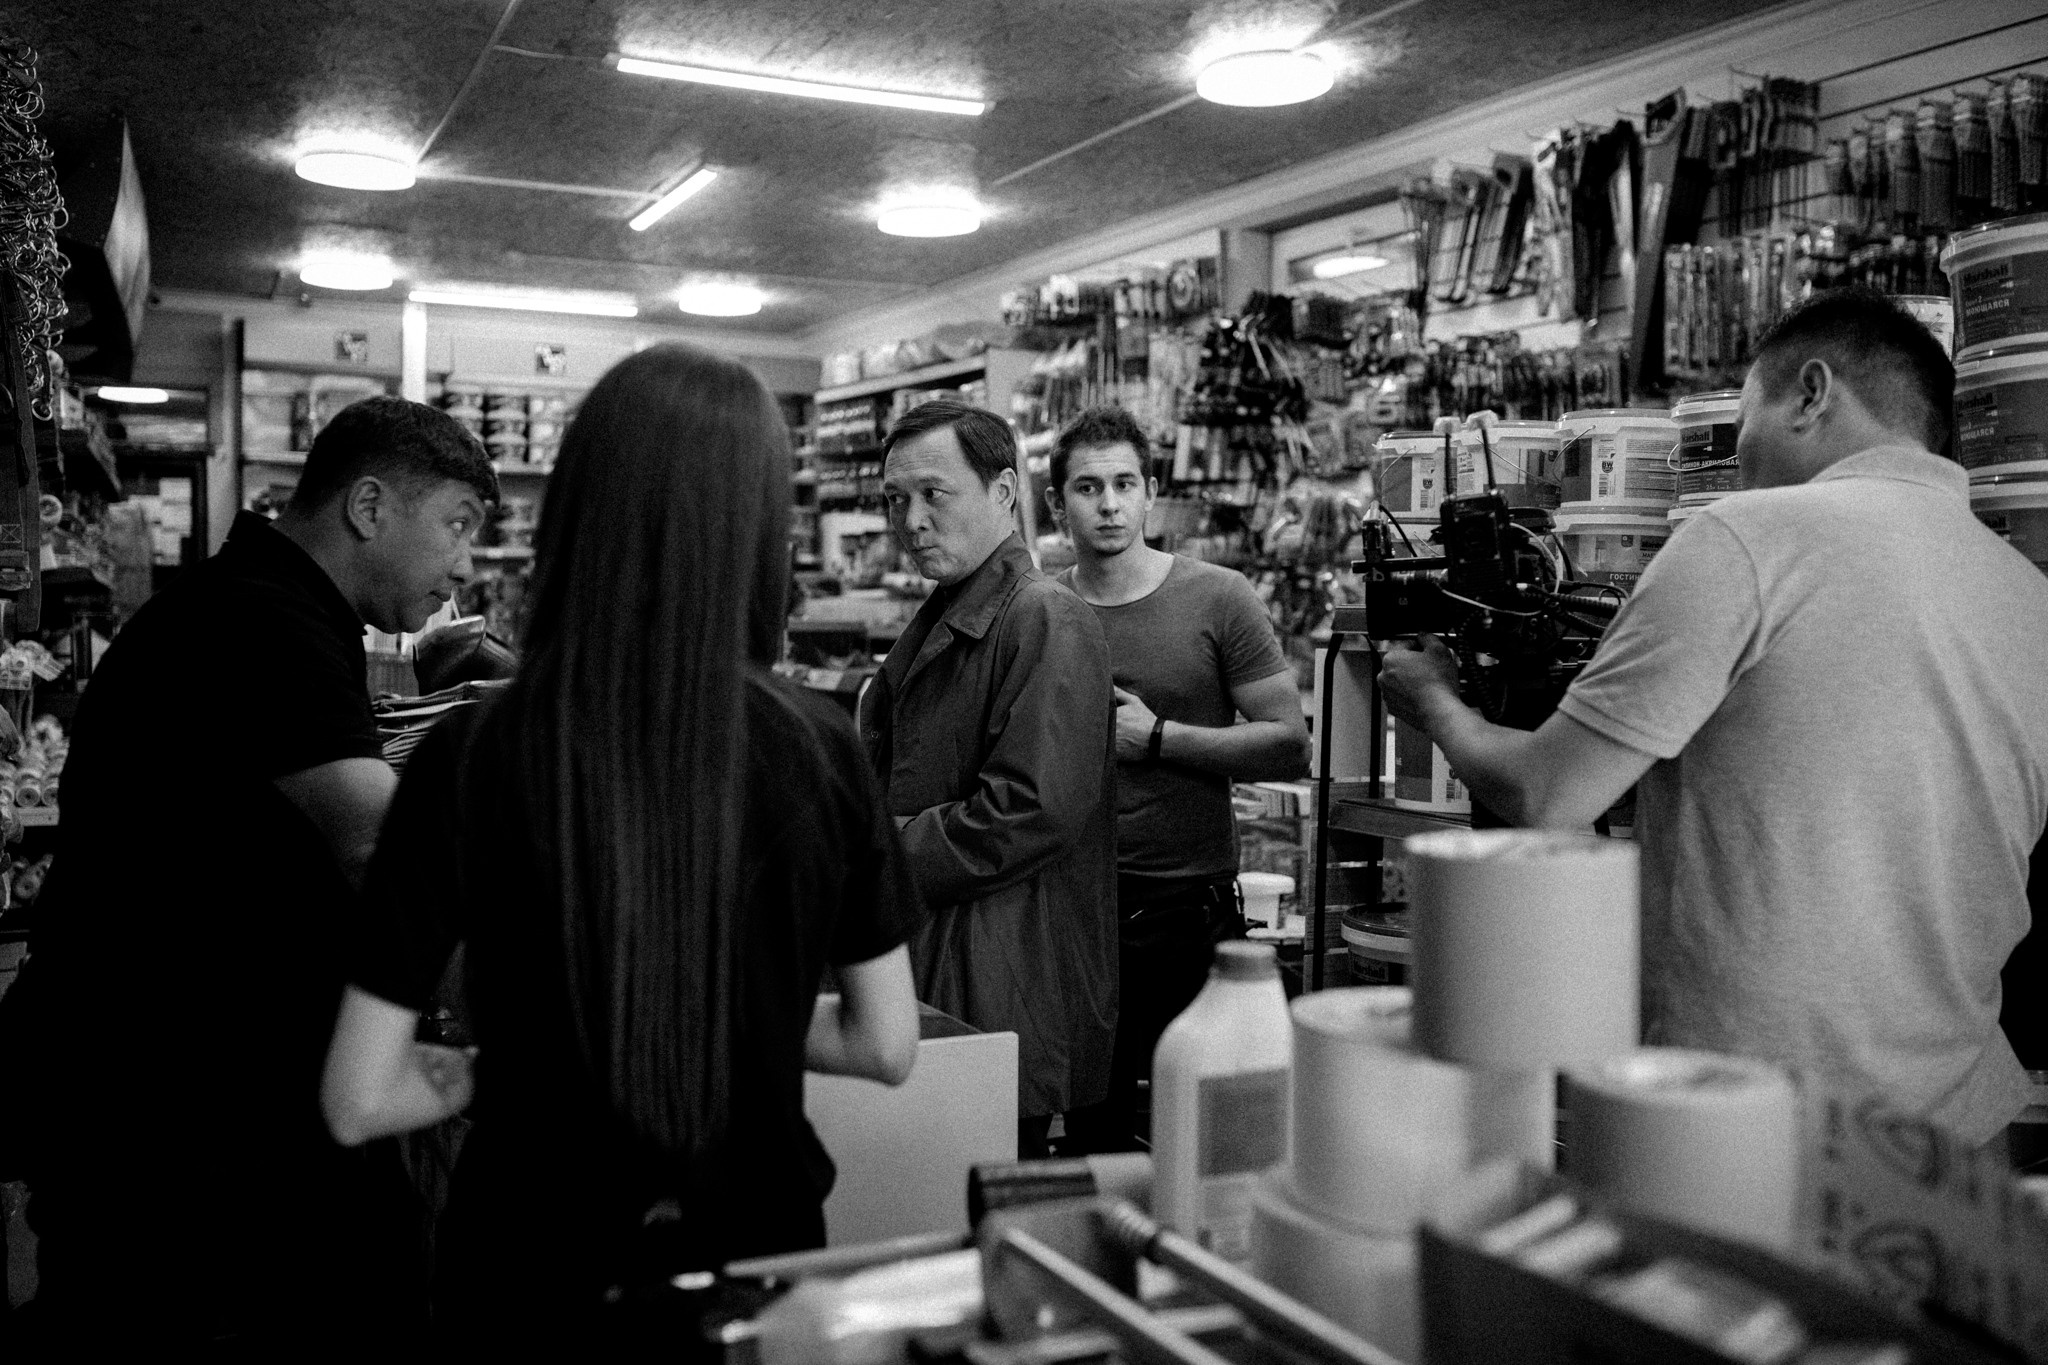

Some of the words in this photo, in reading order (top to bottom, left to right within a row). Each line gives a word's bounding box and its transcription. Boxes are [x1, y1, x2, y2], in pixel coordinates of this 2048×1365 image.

[1964, 264, 2009, 286] Marshall
[1966, 298, 2010, 317] МОЮЩАЯСЯ
[1956, 392, 1994, 411] Marshall
[1681, 431, 1710, 444] Marshall
[1960, 427, 1995, 441] МОЮЩАЯСЯ
